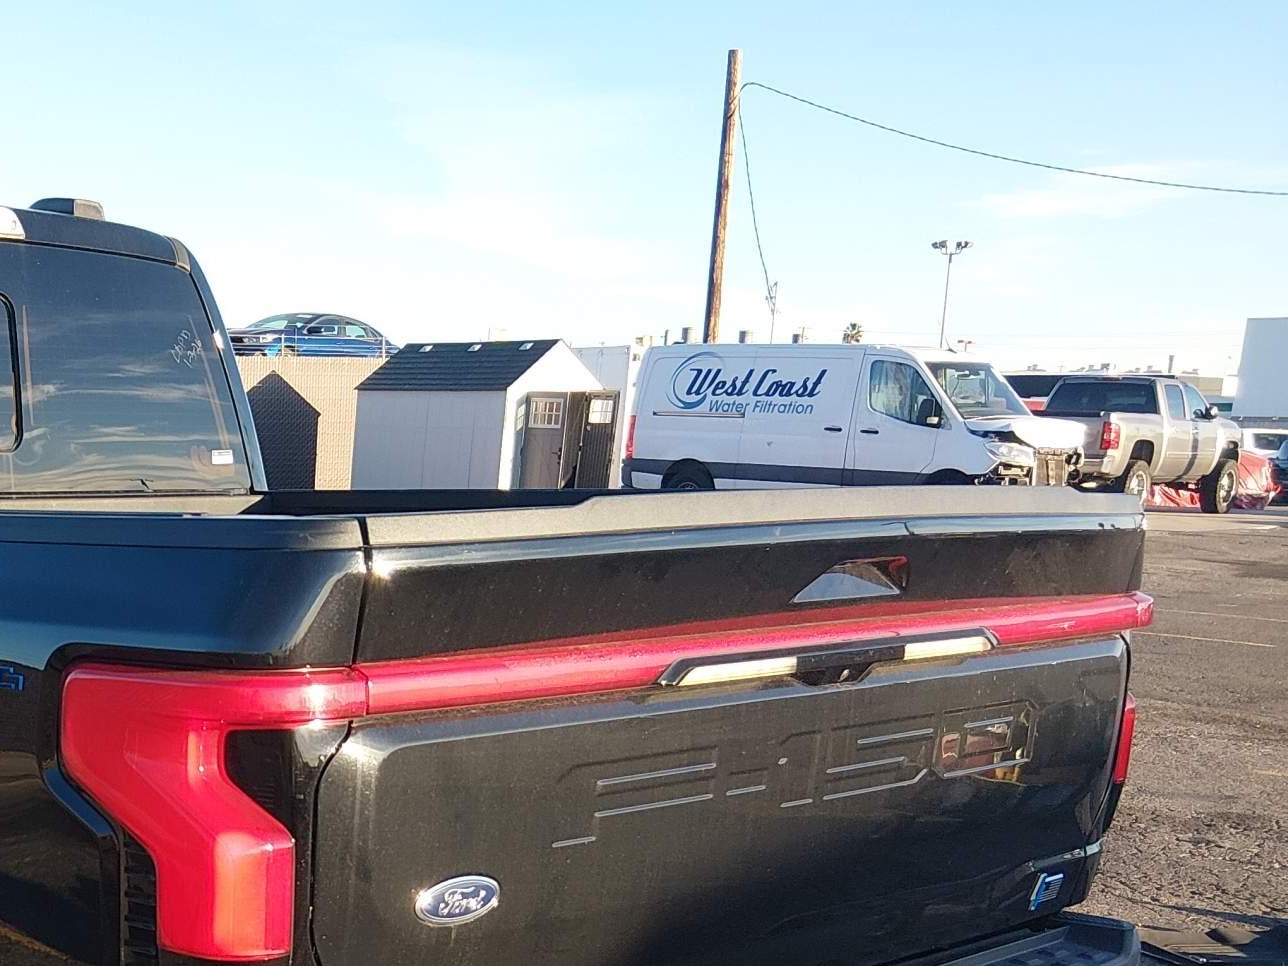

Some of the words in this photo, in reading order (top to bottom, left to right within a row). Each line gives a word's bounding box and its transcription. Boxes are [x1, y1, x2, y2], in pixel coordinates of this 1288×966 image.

[685, 368, 755, 397] West
[752, 368, 827, 398] Coast
[709, 400, 750, 413] Water
[752, 399, 814, 415] Filtration
[438, 886, 487, 917] Ford
